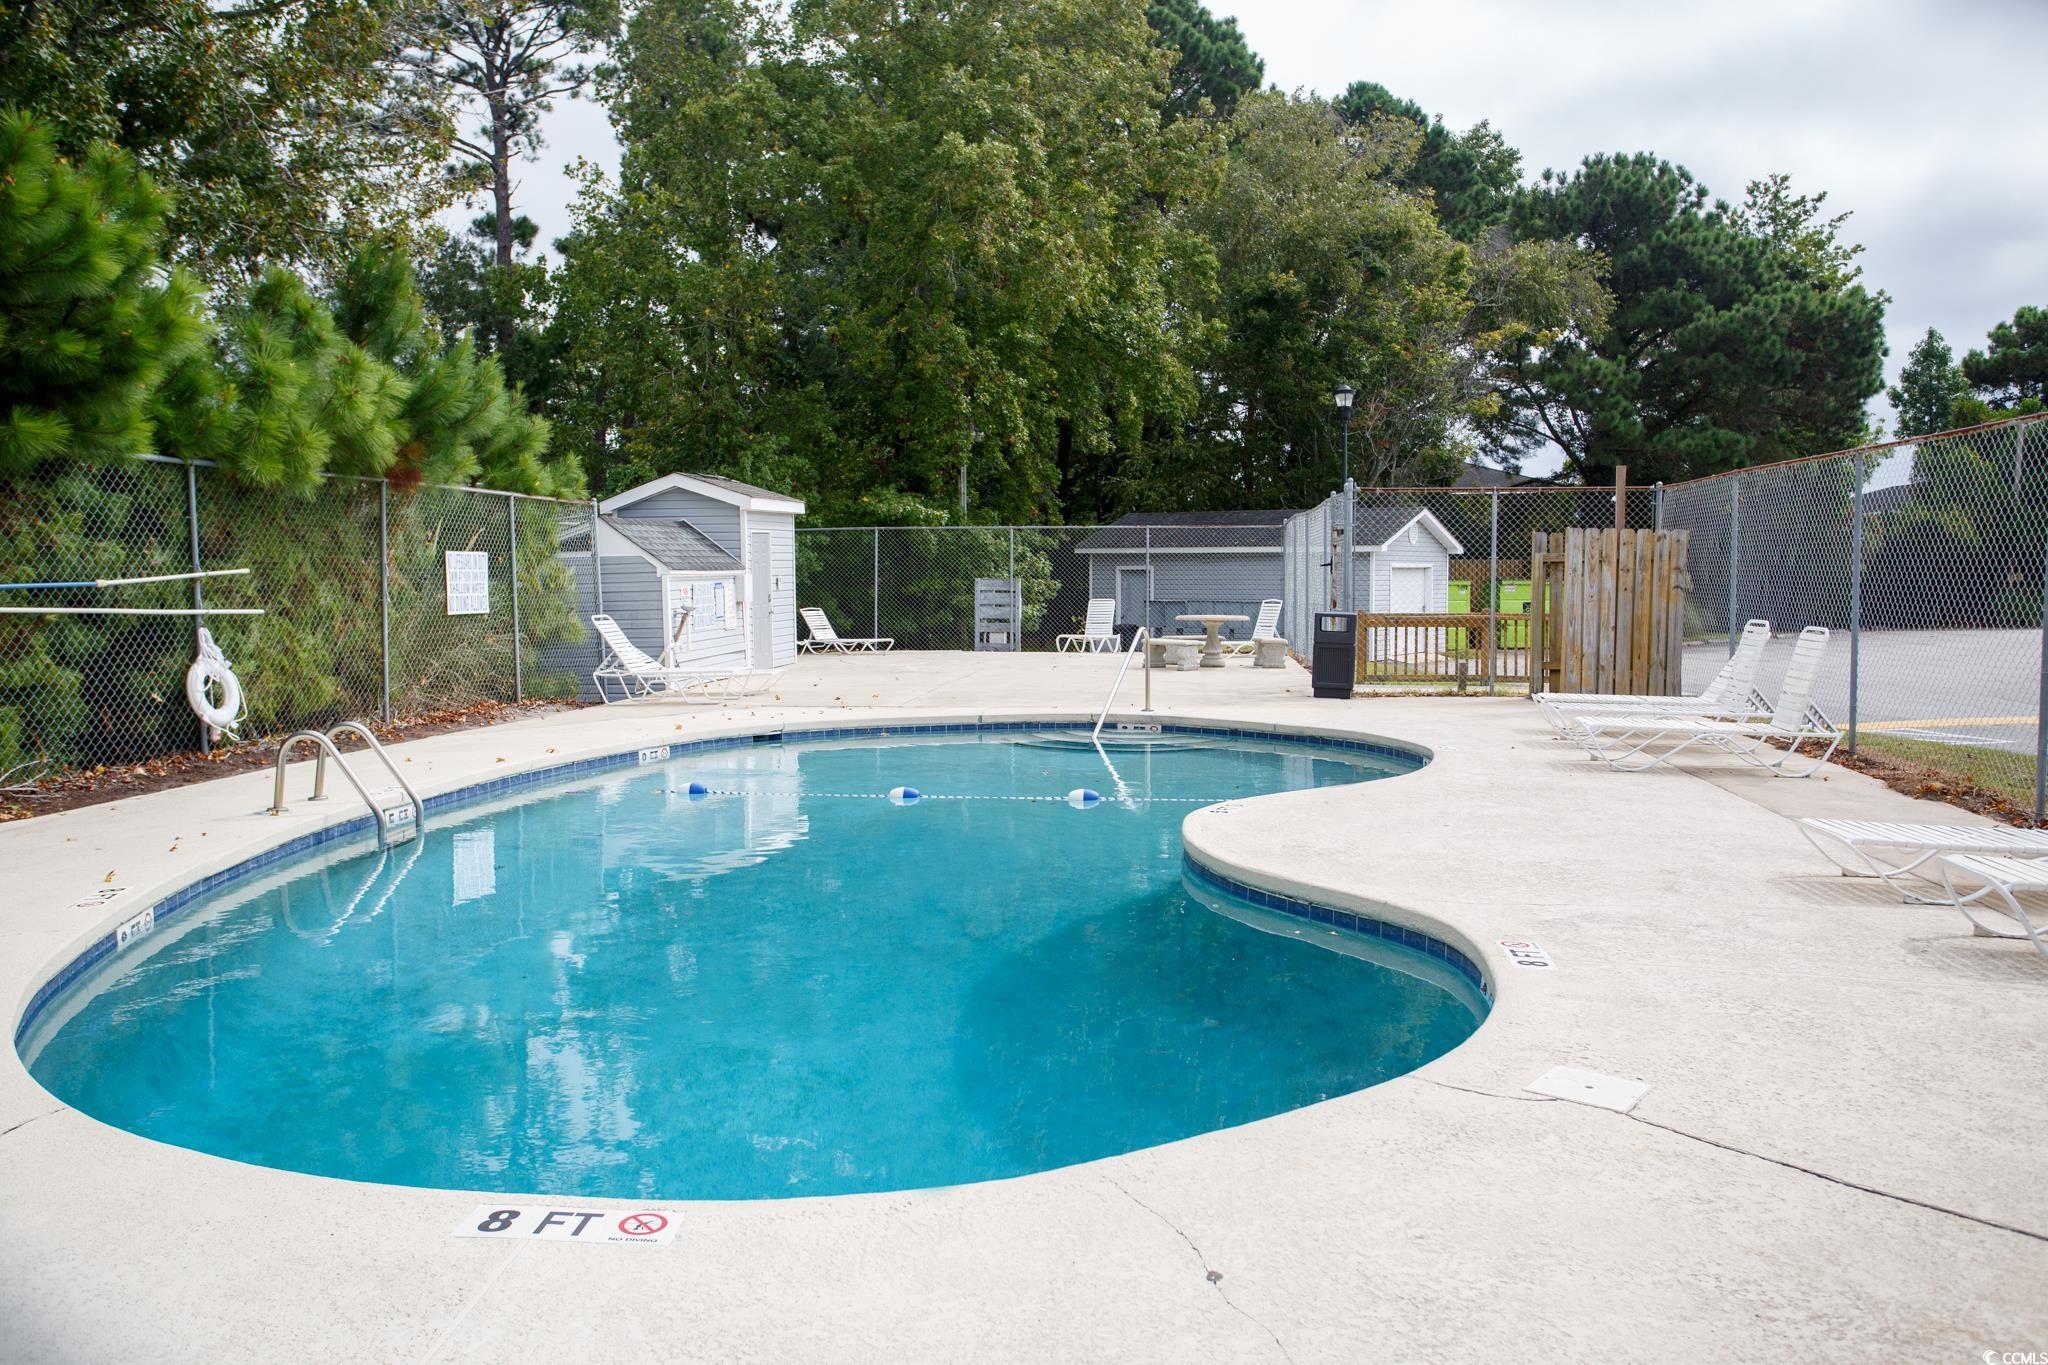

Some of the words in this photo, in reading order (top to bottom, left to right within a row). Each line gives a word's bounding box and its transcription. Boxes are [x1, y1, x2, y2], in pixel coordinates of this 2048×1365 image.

[449, 583, 470, 594] SHALLOW
[472, 582, 486, 594] WATER
[1509, 949, 1545, 959] FT
[477, 1209, 521, 1233] 8
[532, 1211, 605, 1236] FT
